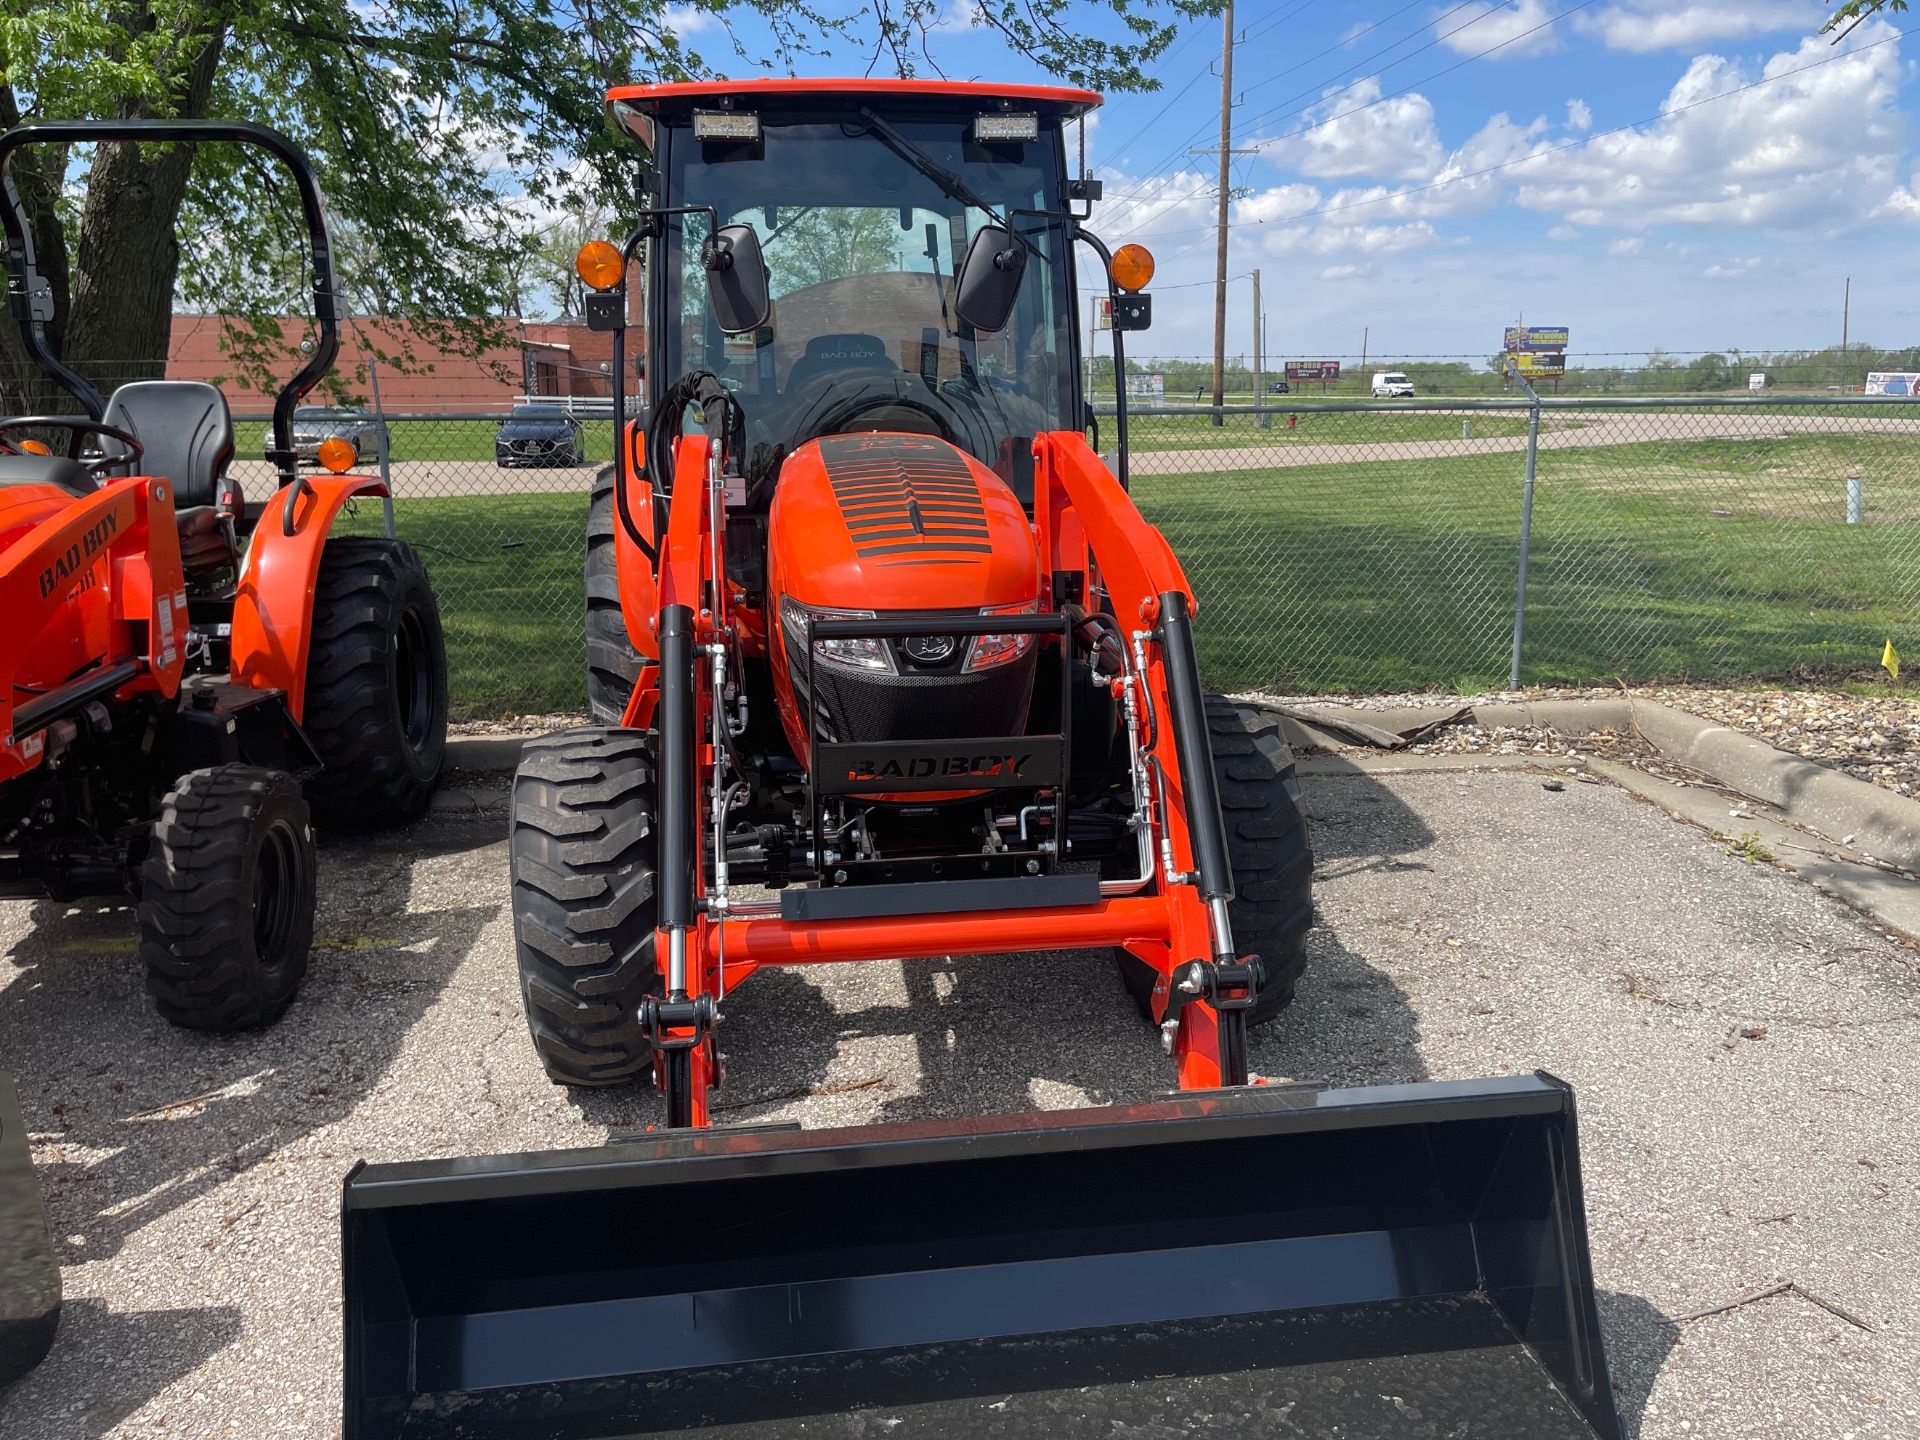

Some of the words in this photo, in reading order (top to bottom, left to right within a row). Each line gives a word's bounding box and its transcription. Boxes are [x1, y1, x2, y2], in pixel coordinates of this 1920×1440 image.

[38, 543, 81, 599] BAD
[82, 506, 117, 558] BOY
[848, 758, 937, 780] BAD
[941, 754, 1032, 778] BOY
